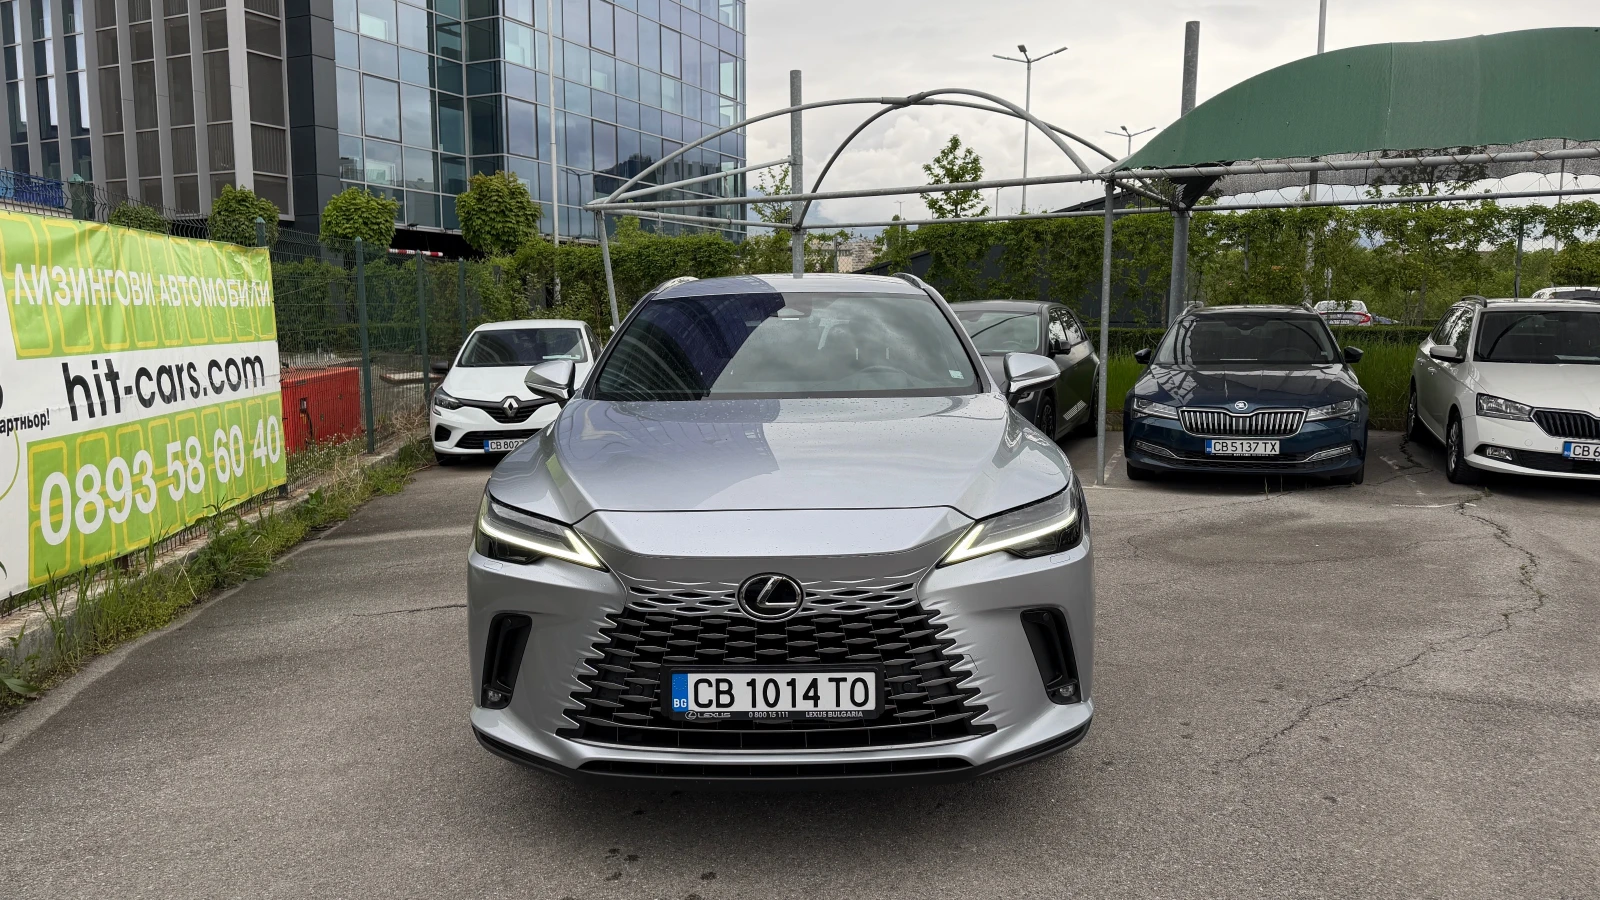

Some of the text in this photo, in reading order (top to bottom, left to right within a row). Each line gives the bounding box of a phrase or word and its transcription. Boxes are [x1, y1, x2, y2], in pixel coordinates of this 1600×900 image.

[14, 263, 272, 308] ЛИЗИНГОВИ АВТОМОБИЛИ
[62, 353, 266, 421] hit-cars.com
[490, 441, 502, 449] CB
[1213, 441, 1228, 452] CB
[1231, 442, 1259, 452] 5137
[1261, 441, 1277, 453] TX
[1573, 445, 1590, 456] CB
[40, 415, 281, 546] 0893 58 60 40
[673, 698, 687, 708] BG
[693, 677, 869, 709] CB 1014 TO
